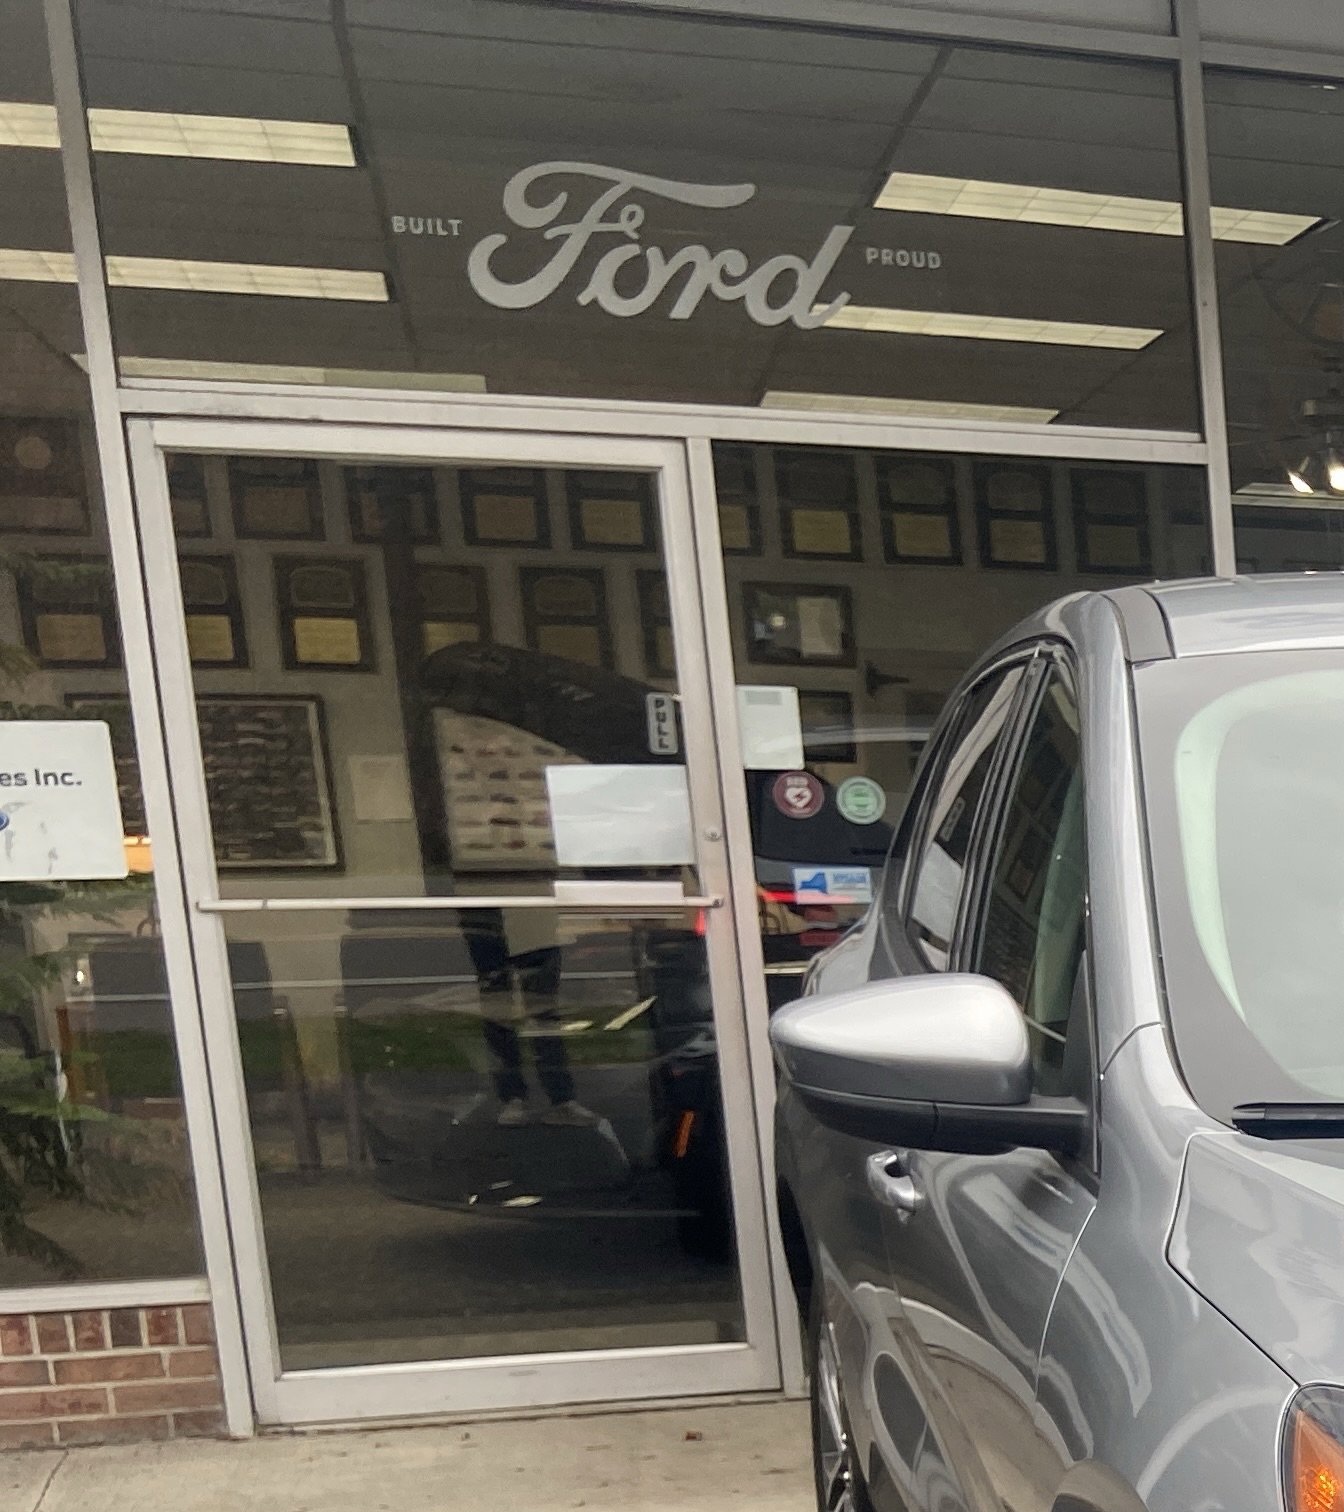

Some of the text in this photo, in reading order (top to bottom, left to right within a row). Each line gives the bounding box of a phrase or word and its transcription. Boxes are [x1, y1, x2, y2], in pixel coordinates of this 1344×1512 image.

[391, 160, 942, 330] BUILT Ford PROUD
[655, 698, 669, 749] PULL
[34, 768, 83, 787] Inc.
